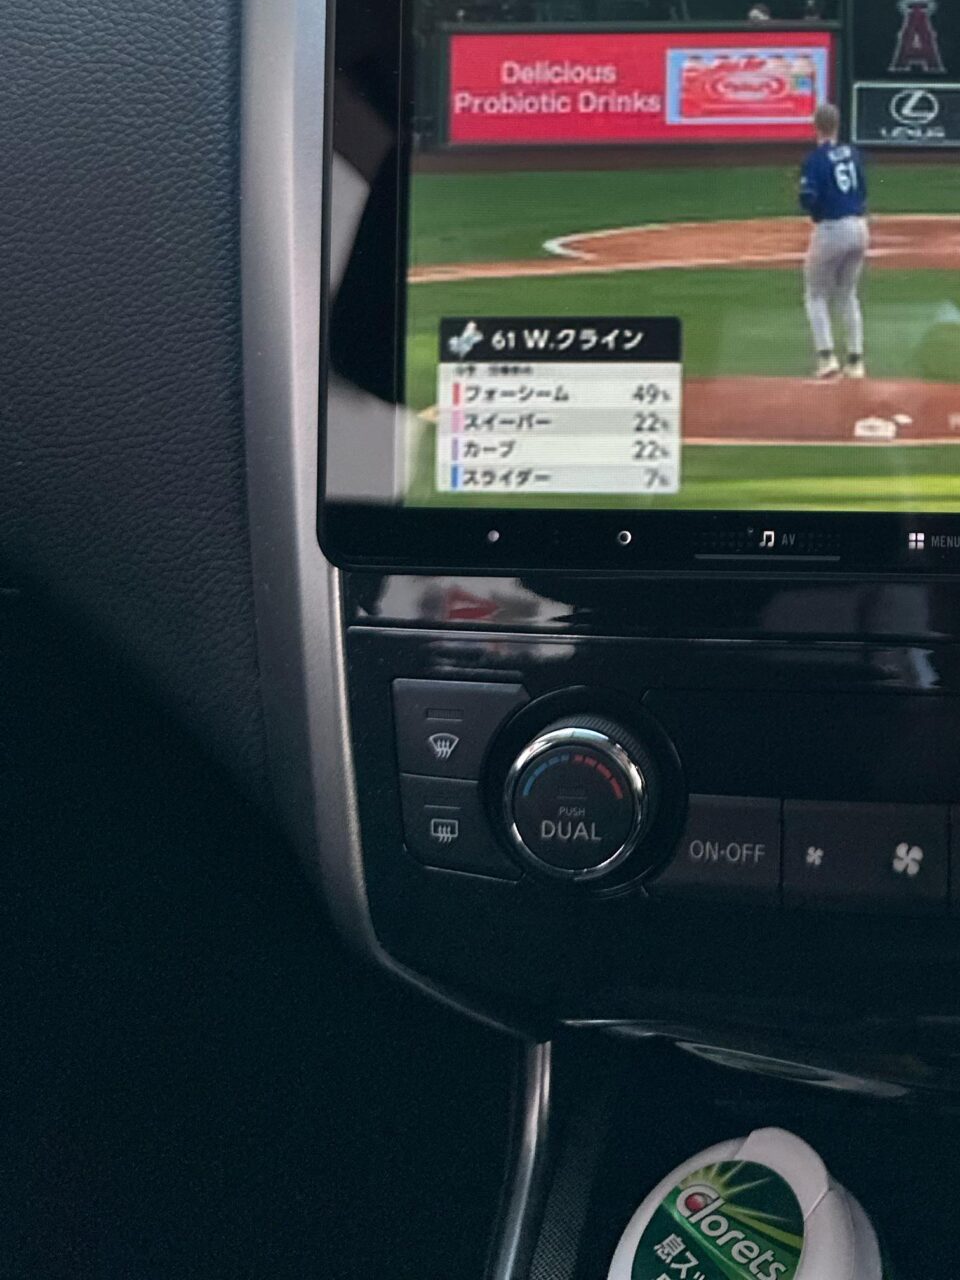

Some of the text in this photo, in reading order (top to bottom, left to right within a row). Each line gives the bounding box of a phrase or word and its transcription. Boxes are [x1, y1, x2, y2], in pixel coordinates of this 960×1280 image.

[502, 60, 617, 84] Delicious
[454, 90, 662, 114] Probiotic Drinks
[834, 161, 858, 193] 61
[491, 328, 643, 351] 61 W.クライン
[465, 385, 569, 402] フォーシーム
[464, 413, 551, 431] スイーパー
[464, 440, 516, 458] カーブ
[463, 468, 551, 486] スライダー
[781, 533, 796, 546] AV
[931, 535, 960, 549] MENU
[558, 806, 586, 817] PUSH
[541, 820, 602, 841] DUAL
[676, 1184, 787, 1280] Clorets
